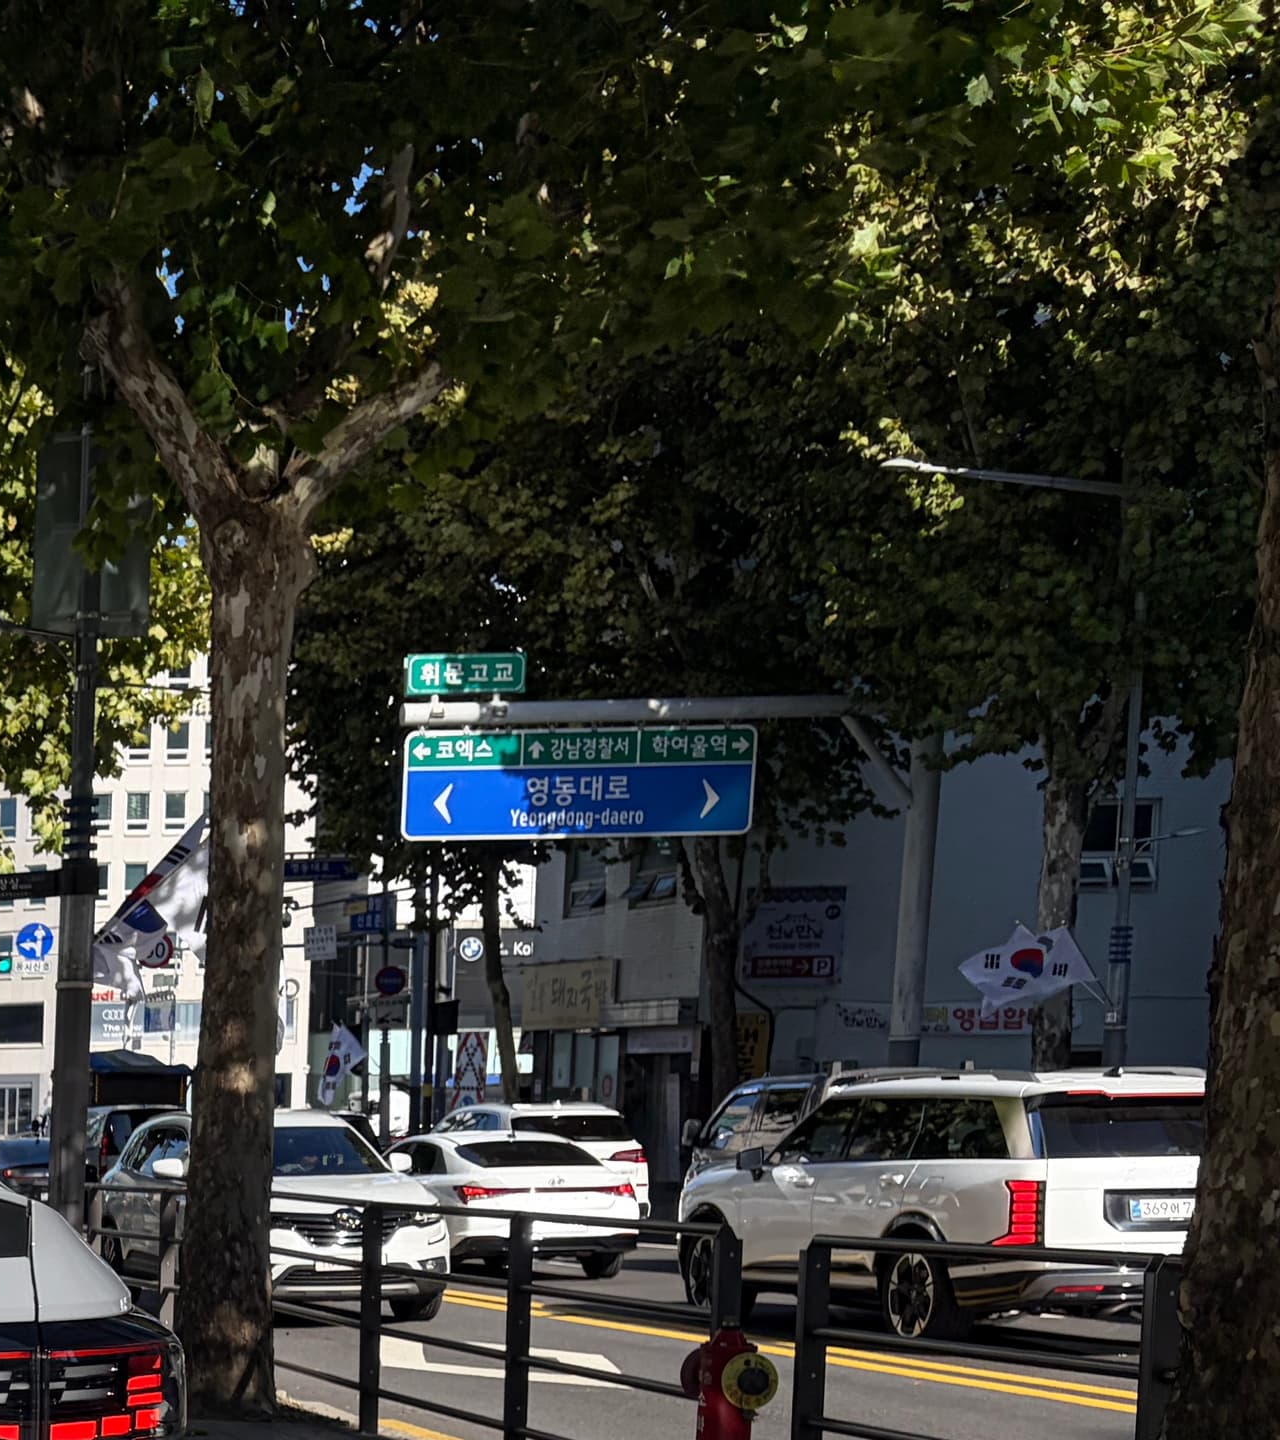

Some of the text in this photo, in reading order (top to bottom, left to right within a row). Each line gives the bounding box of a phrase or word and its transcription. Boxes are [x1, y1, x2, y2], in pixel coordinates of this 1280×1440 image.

[419, 662, 515, 686] 휘문고교
[435, 739, 494, 761] 코엑스
[550, 737, 630, 761] 강남경찰서
[652, 735, 728, 758] 학여울역
[526, 775, 632, 806] 영동대로
[510, 807, 644, 831] Yeongdong-daero
